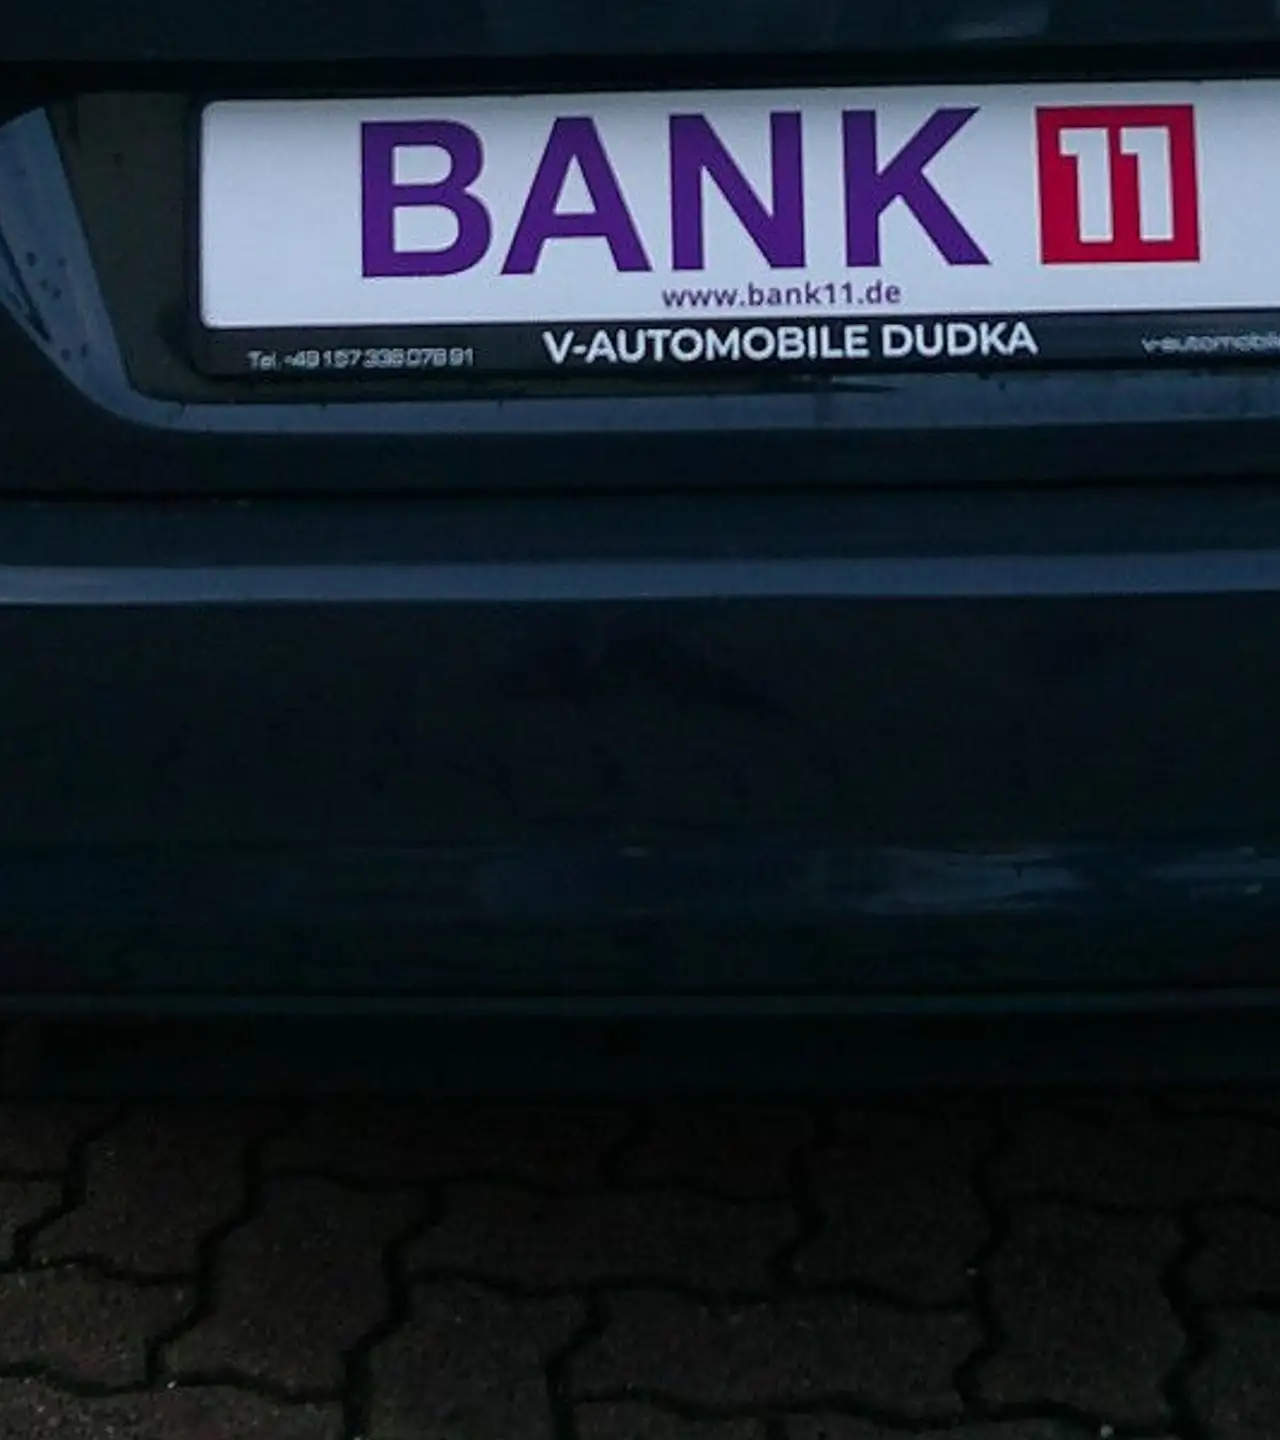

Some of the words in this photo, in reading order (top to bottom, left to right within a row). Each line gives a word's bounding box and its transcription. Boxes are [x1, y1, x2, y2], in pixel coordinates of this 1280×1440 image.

[361, 107, 992, 278] BANK
[1058, 125, 1175, 243] 11
[662, 280, 901, 308] www.bank11.de
[542, 323, 870, 364] V-AUTOMOBILE
[881, 321, 1039, 357] DUDKA
